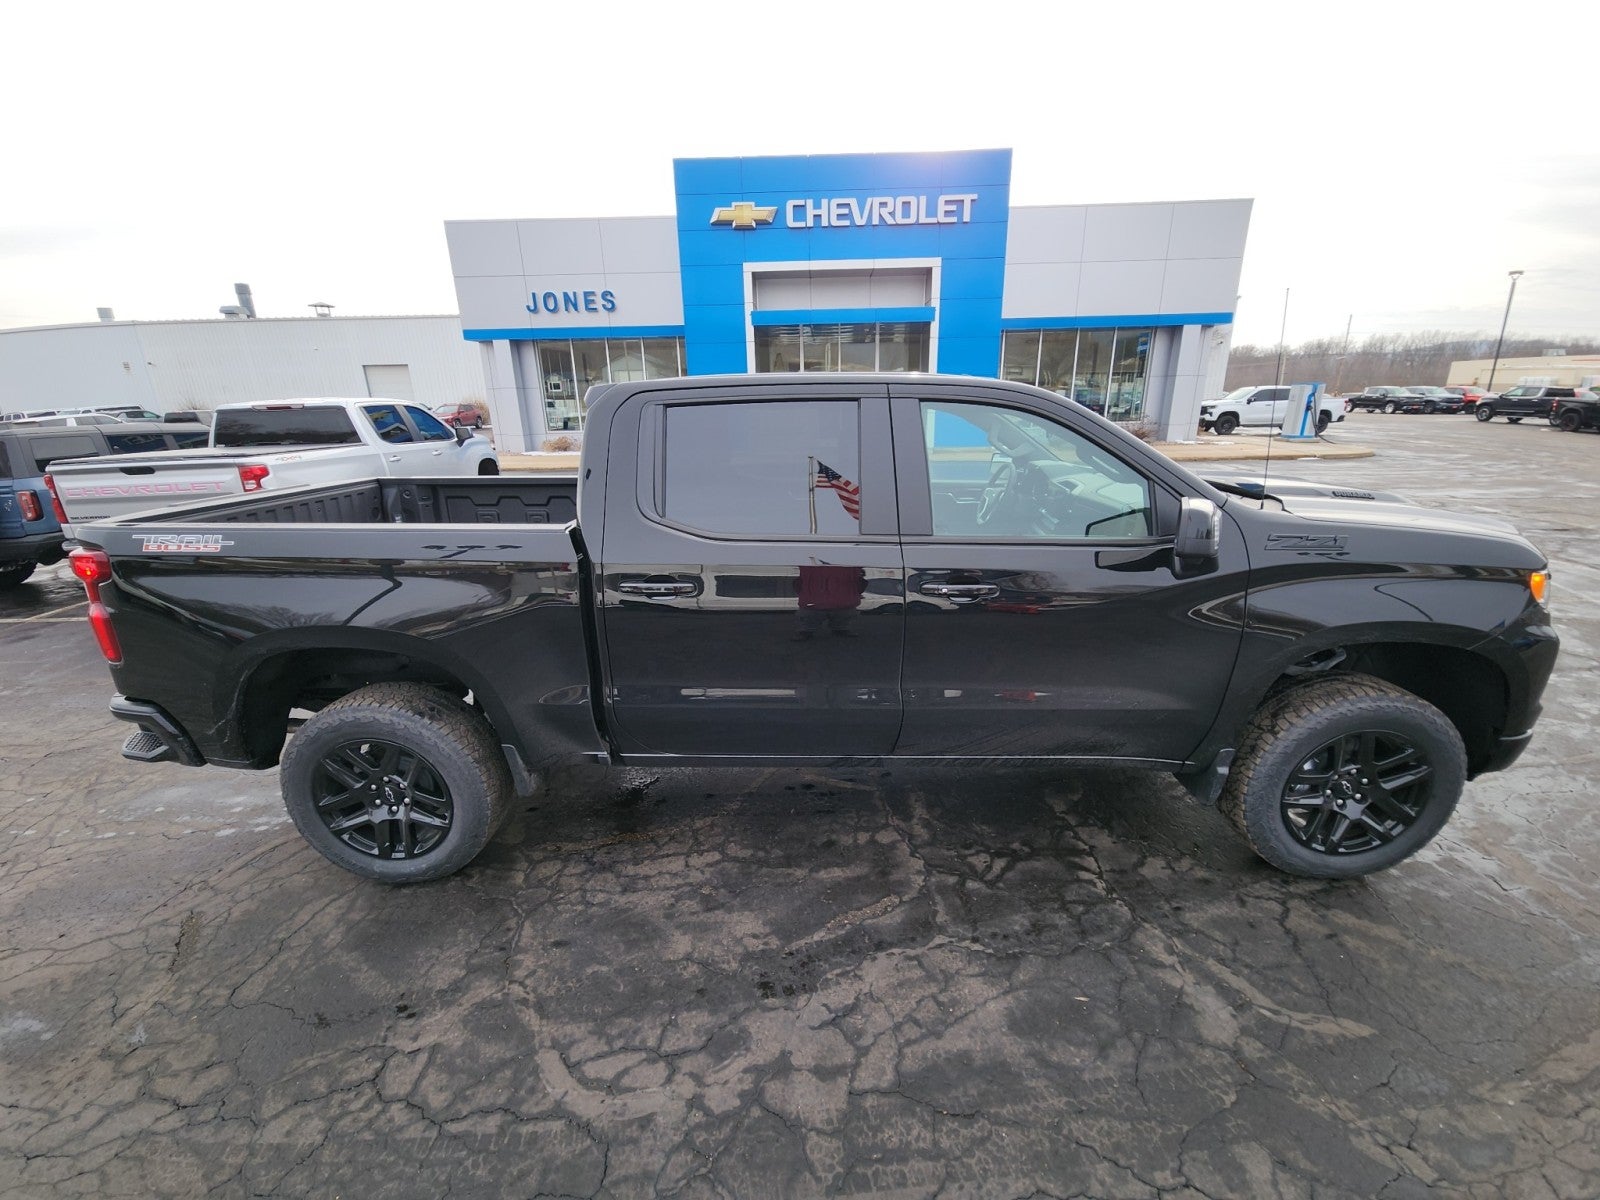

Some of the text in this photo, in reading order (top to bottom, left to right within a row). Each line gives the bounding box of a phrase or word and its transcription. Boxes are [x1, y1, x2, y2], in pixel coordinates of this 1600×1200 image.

[786, 194, 978, 228] CHEVROLET
[526, 290, 616, 313] JONES
[66, 481, 226, 498] CHEVROLET
[132, 534, 234, 545] TRAIL
[142, 543, 221, 552] BOSS
